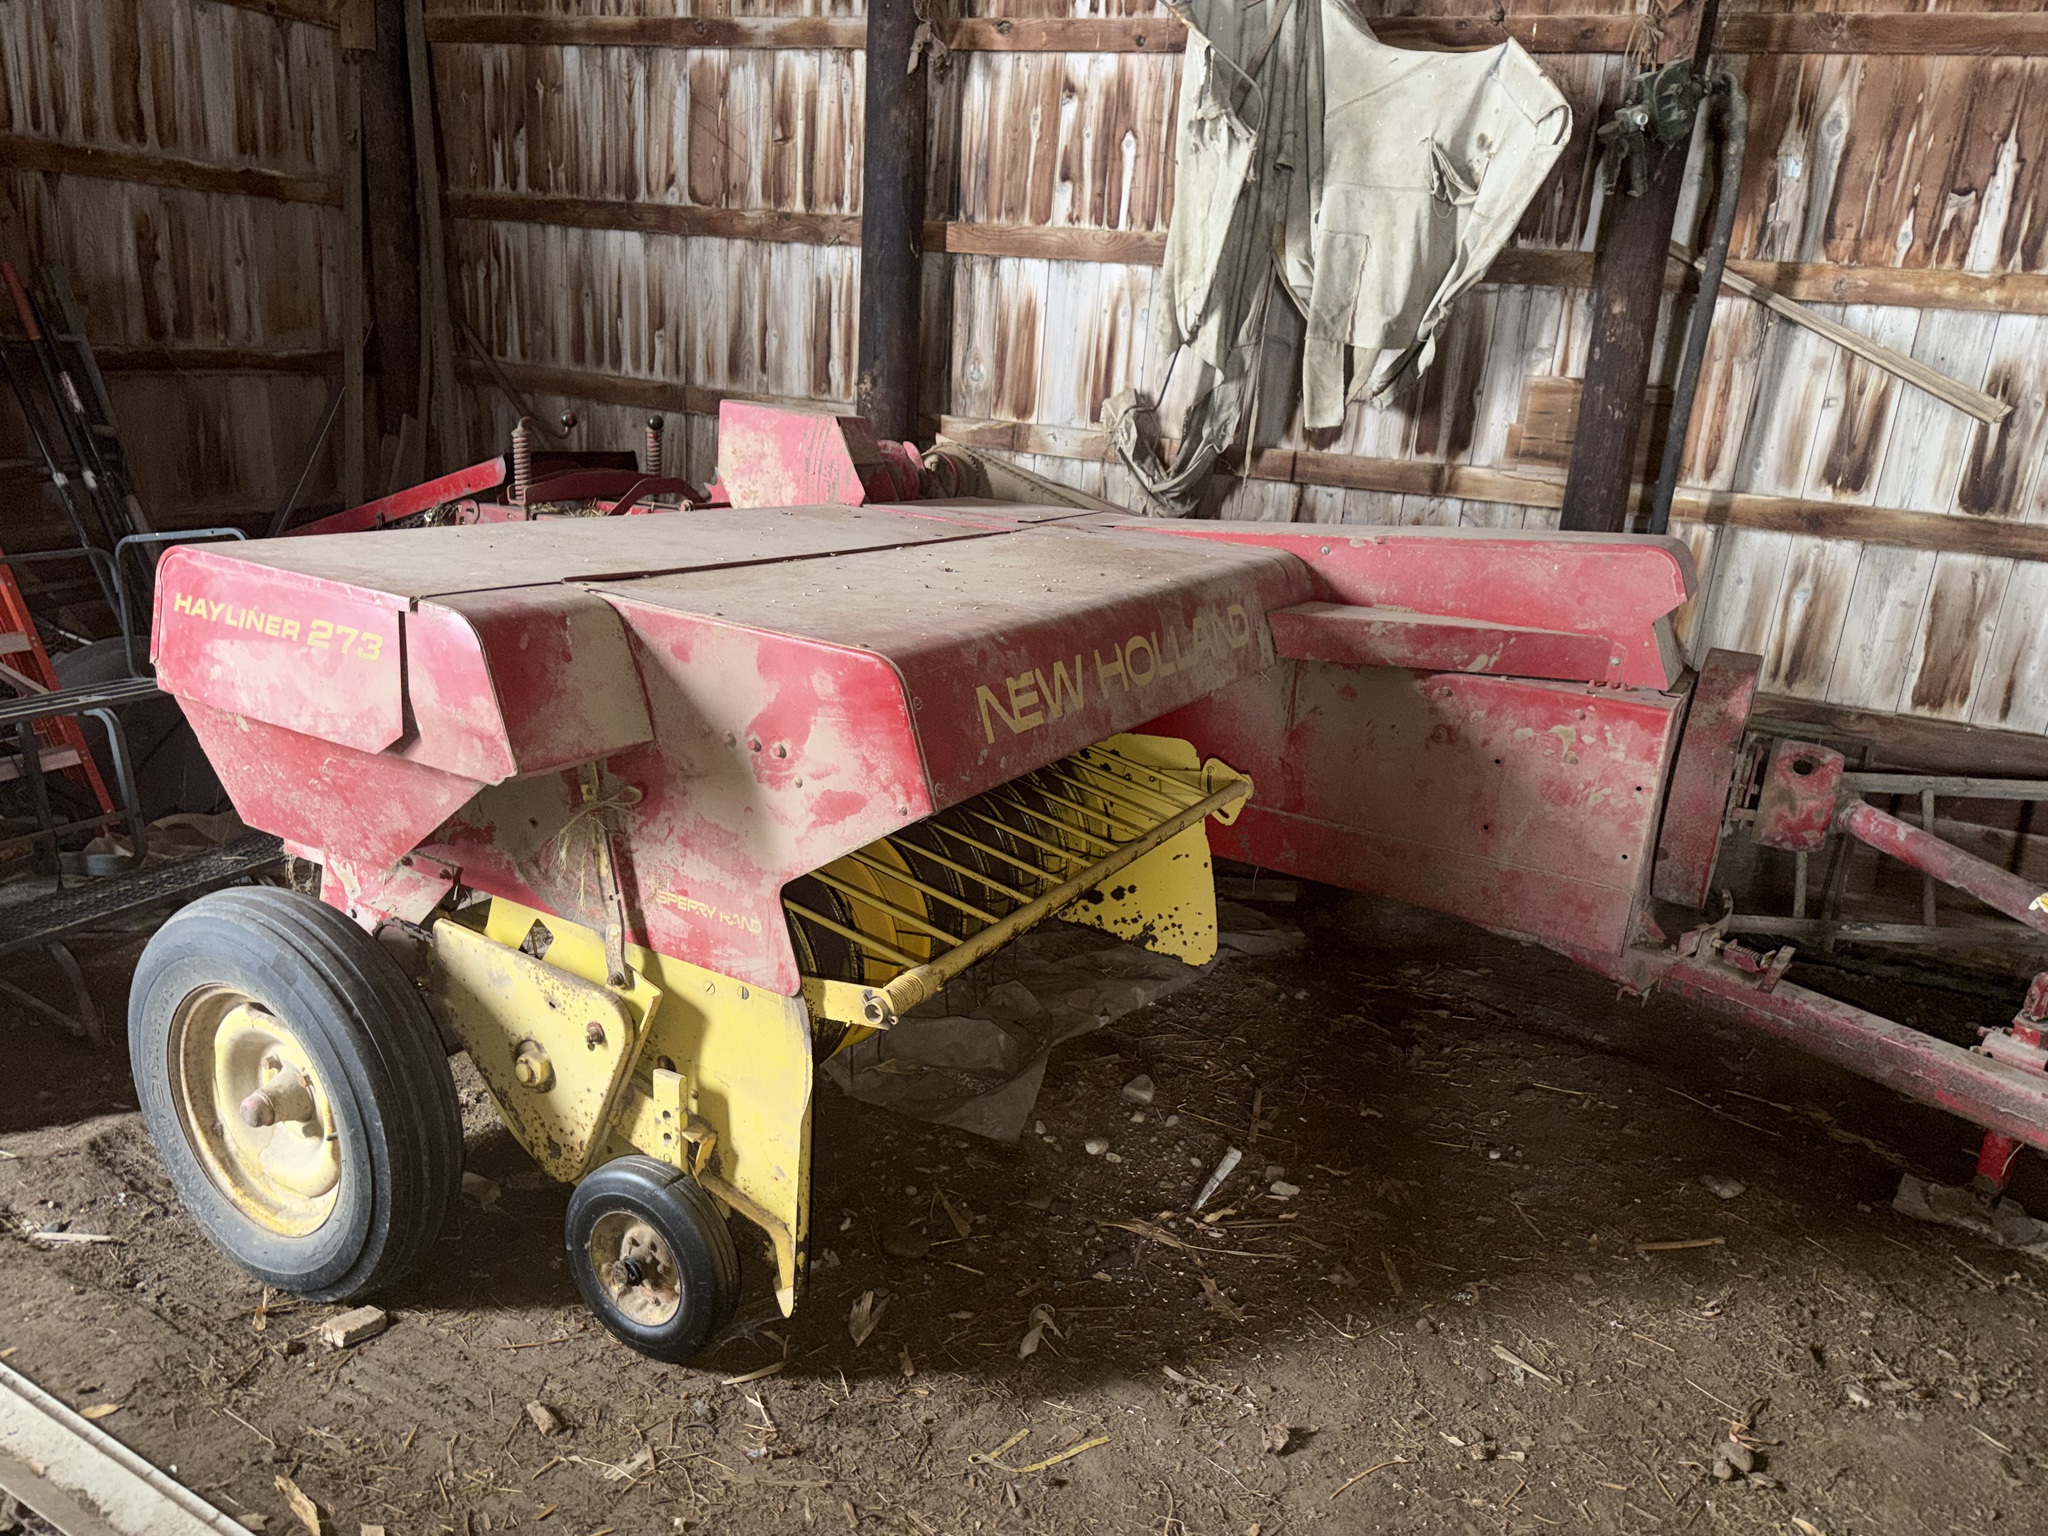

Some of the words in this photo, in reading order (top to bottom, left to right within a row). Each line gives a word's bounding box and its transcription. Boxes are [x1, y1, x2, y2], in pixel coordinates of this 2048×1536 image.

[173, 592, 301, 641] HAYLINER
[307, 619, 384, 661] 273
[975, 654, 1085, 744] NEW
[1093, 603, 1250, 699] HOLLAND
[656, 890, 717, 920] SPERRY
